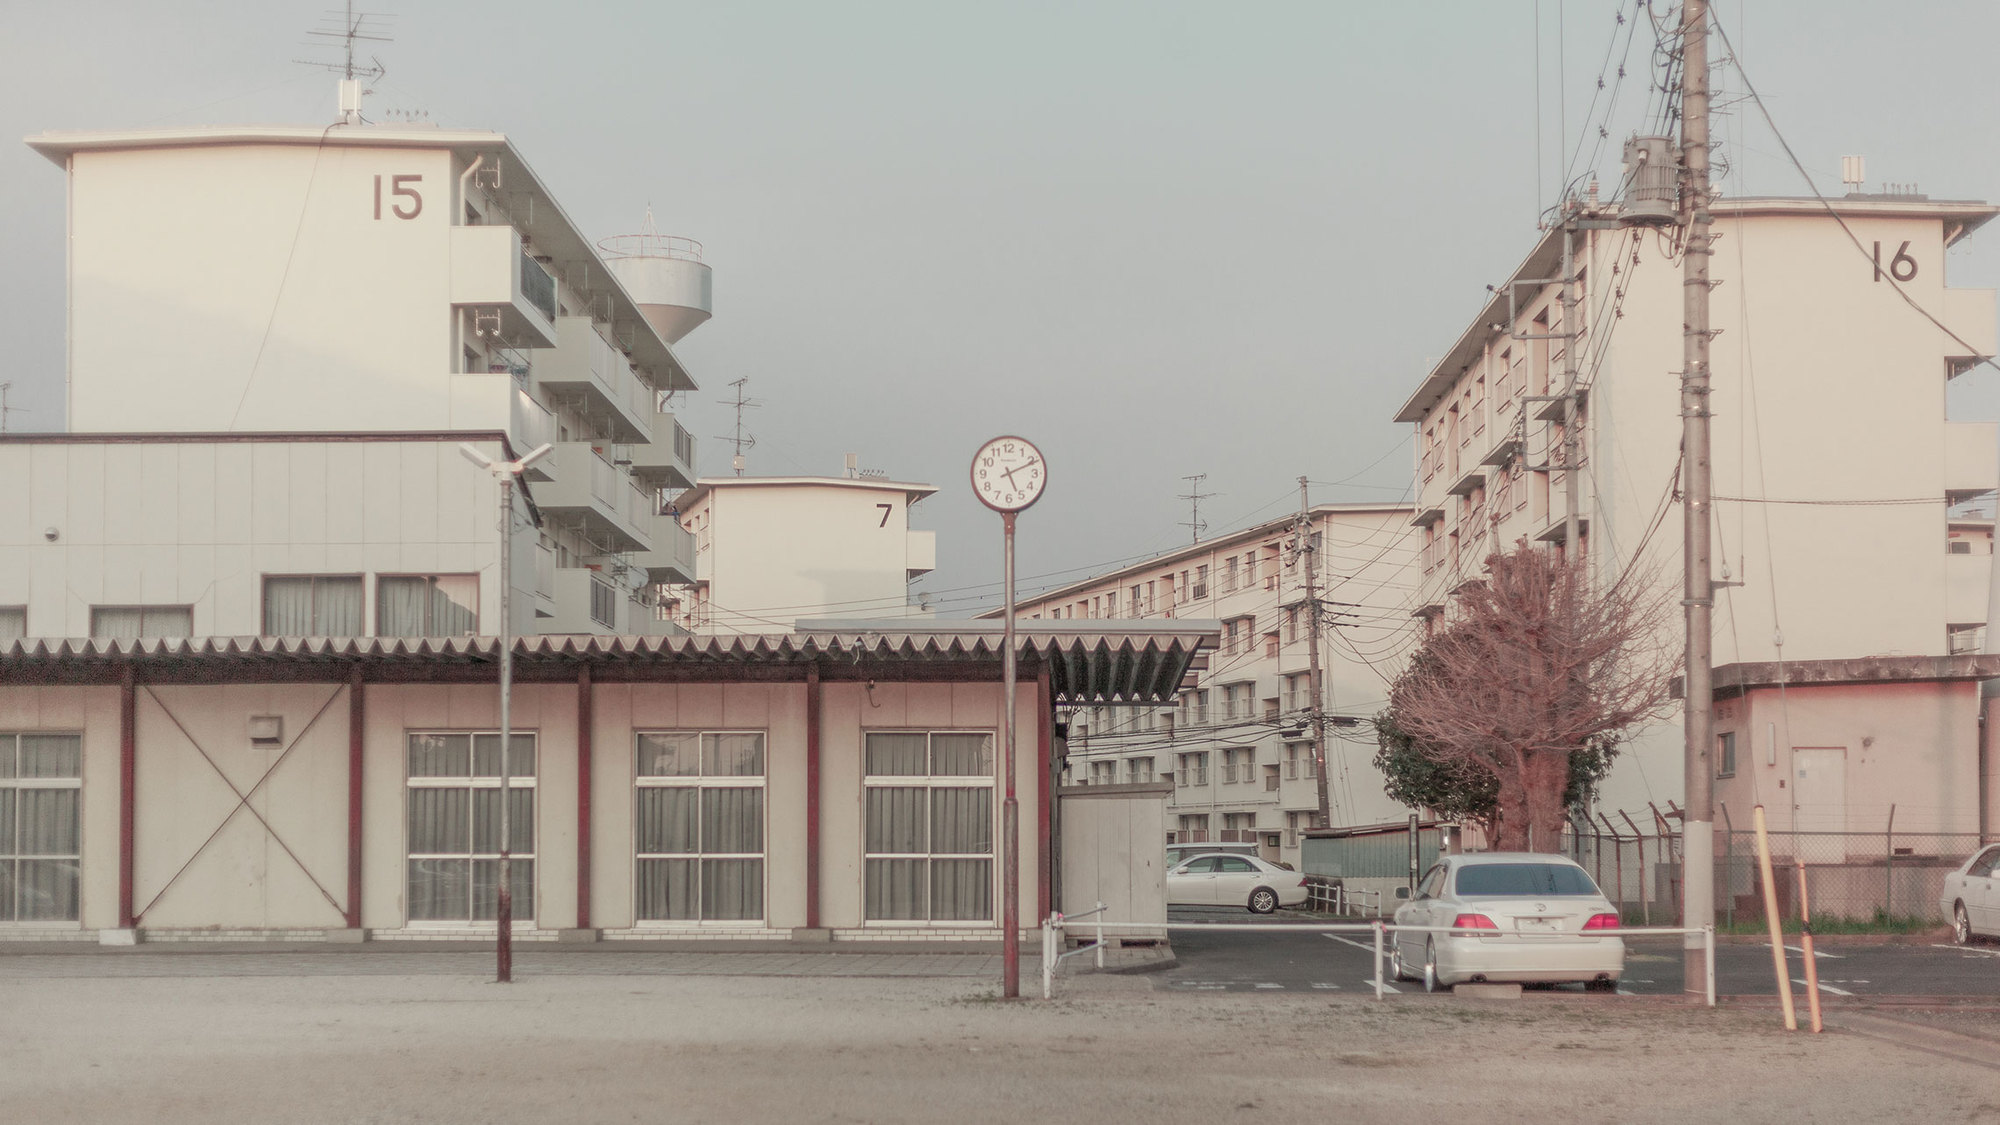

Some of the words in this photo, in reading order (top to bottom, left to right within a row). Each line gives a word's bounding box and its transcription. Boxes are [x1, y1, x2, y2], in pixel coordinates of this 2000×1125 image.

[374, 174, 423, 220] 15
[1873, 240, 1919, 282] 16
[991, 447, 1000, 457] 11
[1003, 443, 1015, 453] 12
[1020, 447, 1024, 457] 1
[982, 457, 994, 467] 10
[1027, 455, 1035, 465] 2
[979, 469, 987, 479] 9
[1031, 469, 1039, 479] 3
[983, 481, 991, 491] 8
[1026, 481, 1034, 491] 4
[993, 490, 1001, 500] 7
[1005, 493, 1013, 503] 6
[1018, 490, 1026, 500] 5
[876, 503, 893, 528] 7
